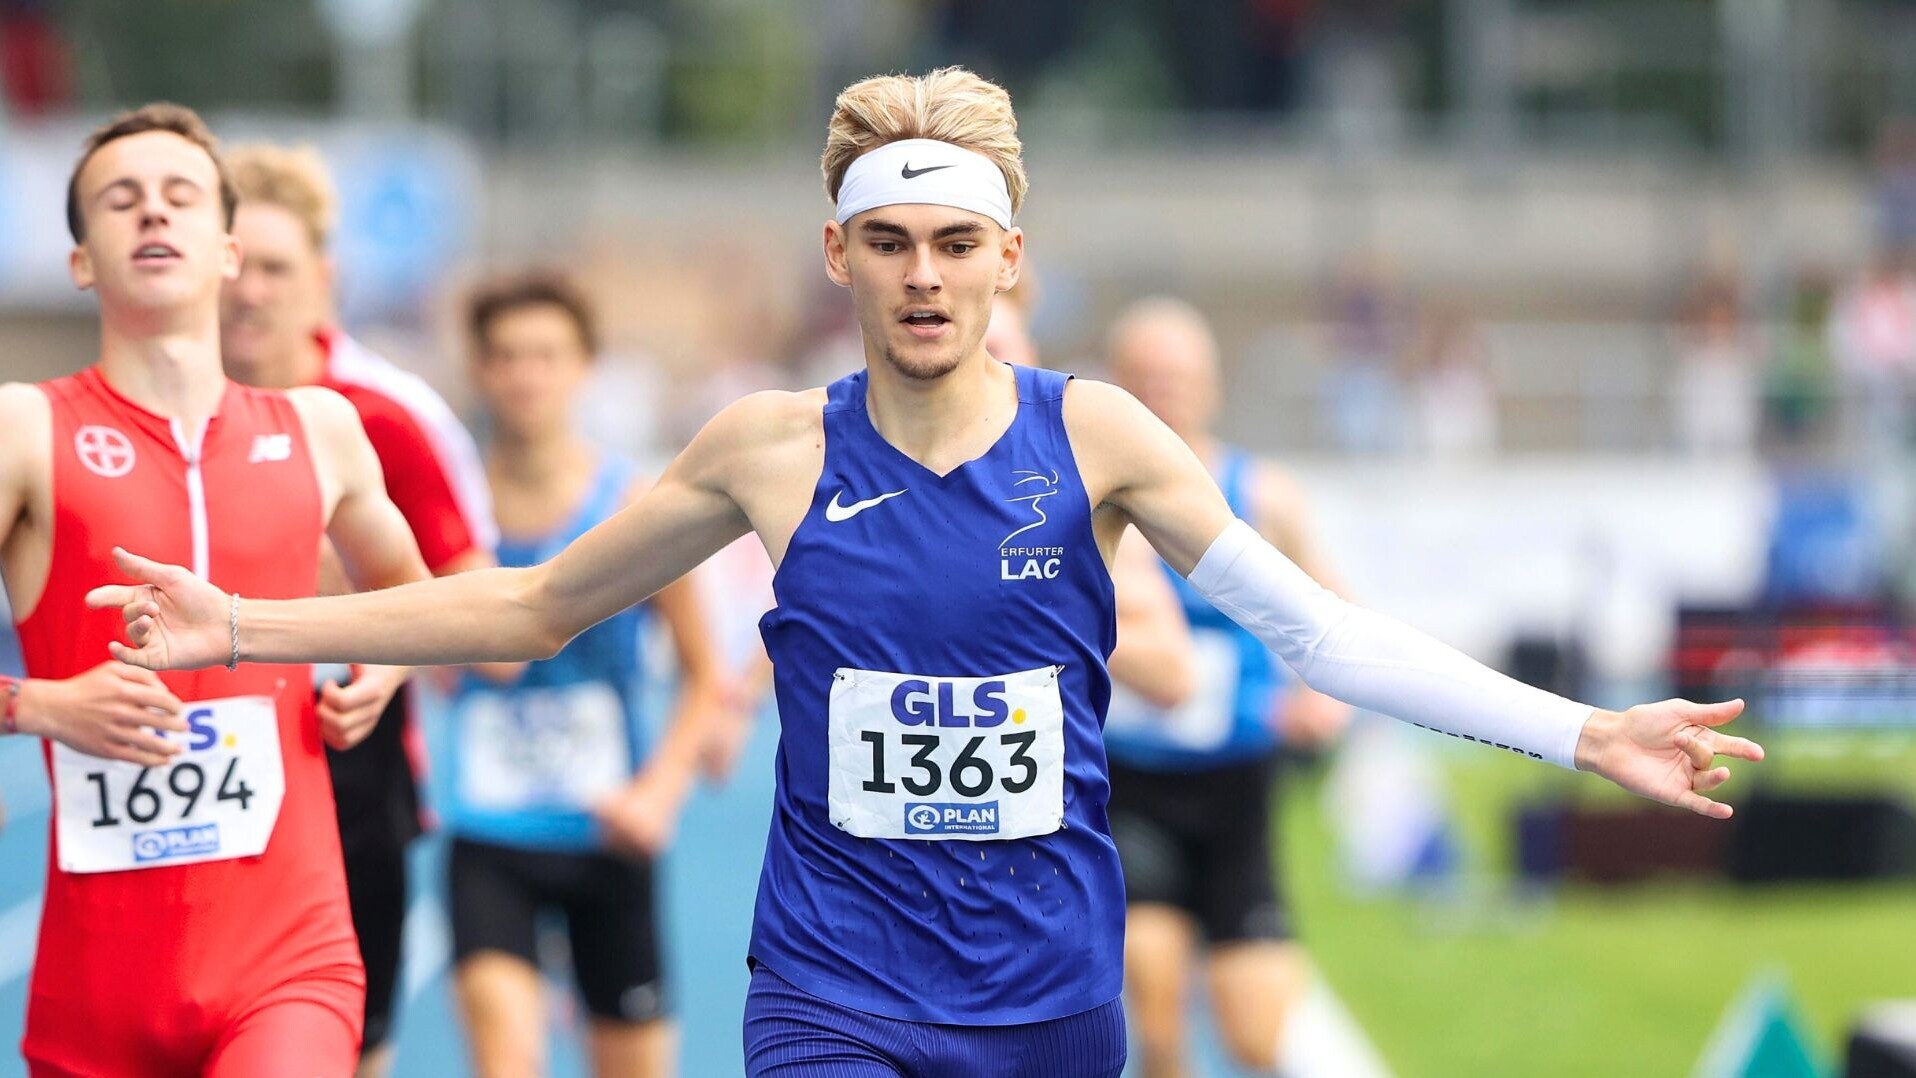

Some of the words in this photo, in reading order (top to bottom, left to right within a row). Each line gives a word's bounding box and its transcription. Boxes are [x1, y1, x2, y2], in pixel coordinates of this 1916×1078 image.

[1001, 547, 1064, 557] ERFURTER
[1001, 558, 1061, 580] LAC
[861, 730, 1038, 797] 1363
[87, 757, 255, 828] 1694
[943, 808, 995, 823] PLAN
